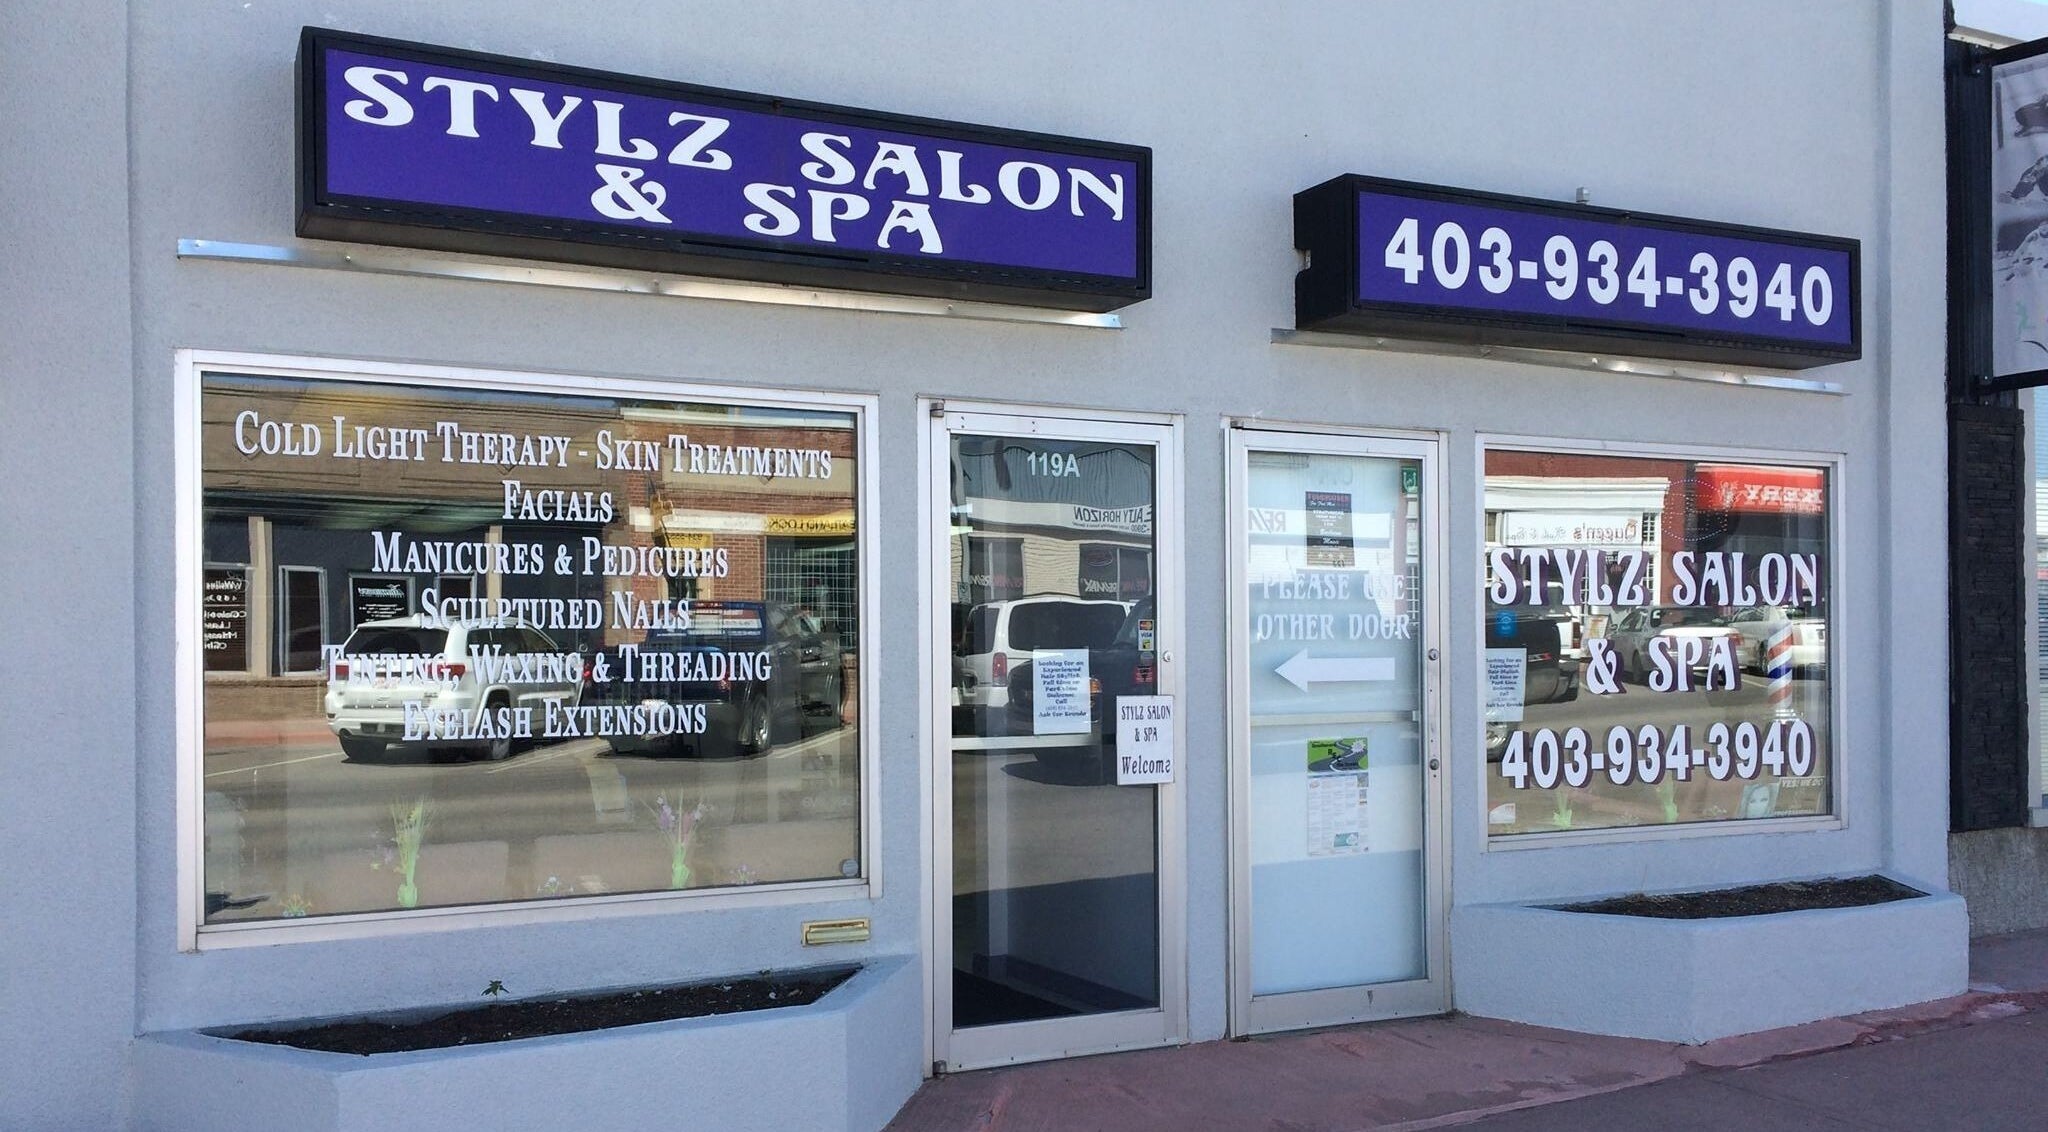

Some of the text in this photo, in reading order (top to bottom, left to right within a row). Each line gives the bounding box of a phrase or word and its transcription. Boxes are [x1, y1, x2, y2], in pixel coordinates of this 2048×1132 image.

[344, 66, 1124, 221] STYLZ SALON
[591, 163, 944, 254] & SPA
[1384, 217, 1833, 326] 403-934-3940
[235, 411, 322, 456] COLD
[332, 415, 428, 461] LIGHT
[436, 421, 571, 468] THERAPY
[596, 430, 660, 471] SKIN
[669, 434, 832, 479] TREATMENTS
[1027, 451, 1081, 477] 119A
[502, 480, 613, 523] FACIALS
[371, 531, 729, 577] MANICURES & PEDICURES
[1263, 574, 1350, 600] PLEASE
[1490, 549, 1820, 606] STYLZ SALON
[421, 587, 603, 630] SCULPTURED
[611, 591, 690, 630] NAILS
[1257, 613, 1411, 640] OTHER DOOR
[469, 644, 584, 684] WAXING
[592, 652, 611, 681] &
[619, 644, 772, 682] THREADING
[1586, 637, 1738, 694] & SPA
[402, 698, 707, 741] EYELASH EXTENSIONS
[1121, 705, 1171, 721] STYLZ SALON
[1134, 727, 1158, 742] & SPA
[1122, 756, 1171, 775] Welcome
[1502, 720, 1813, 789] 403-934-3940
